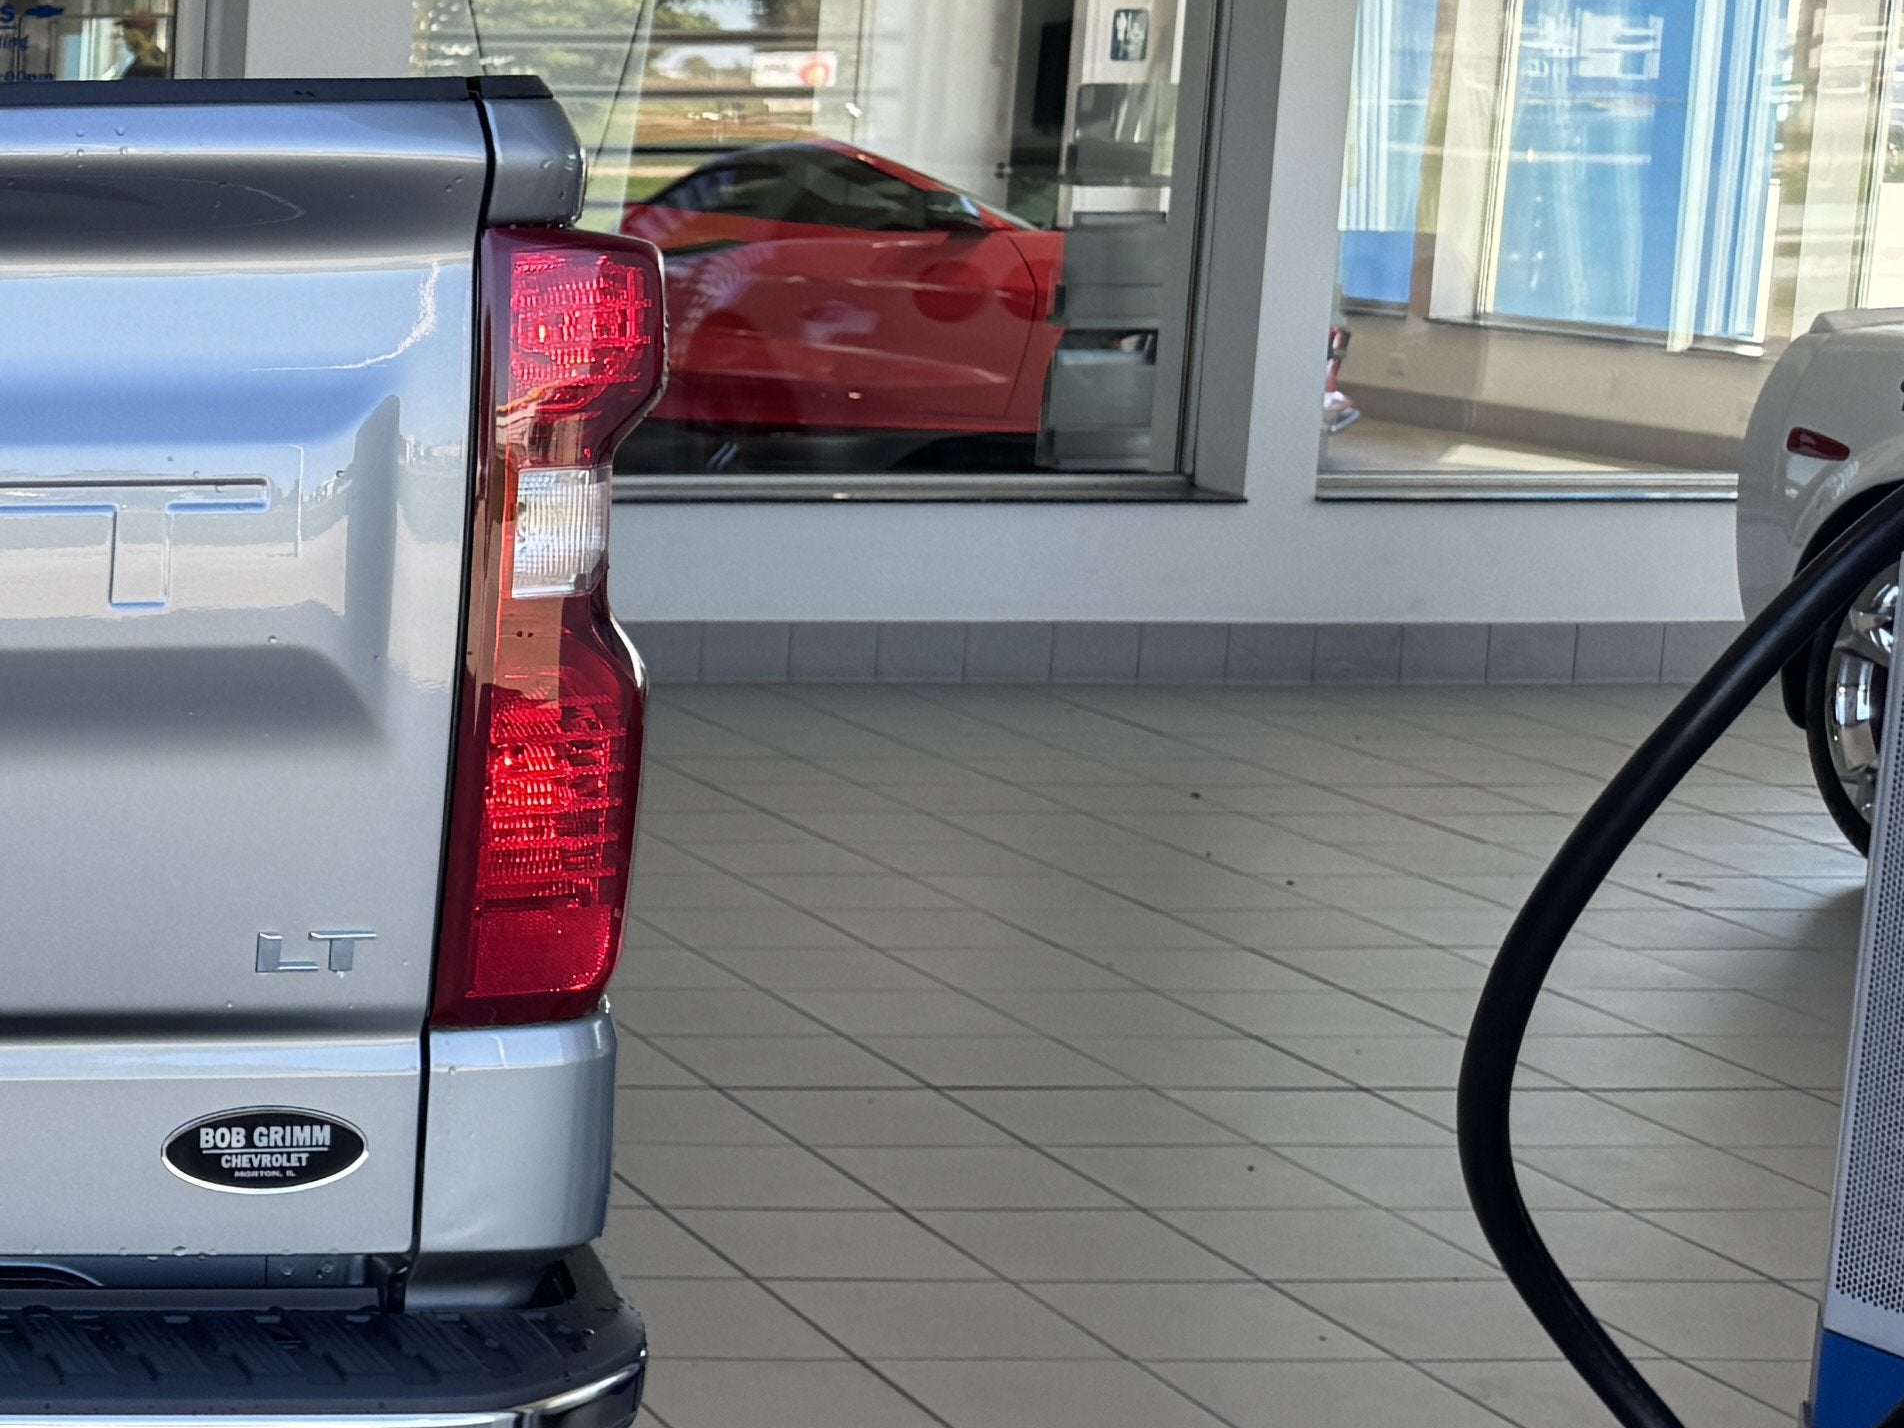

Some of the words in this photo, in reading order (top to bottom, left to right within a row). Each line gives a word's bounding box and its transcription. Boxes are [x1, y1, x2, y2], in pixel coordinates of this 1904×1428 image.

[255, 929, 378, 973] LT
[200, 1127, 246, 1149] BOB
[253, 1125, 331, 1148] GRIMM
[221, 1153, 309, 1169] CHEVROLET
